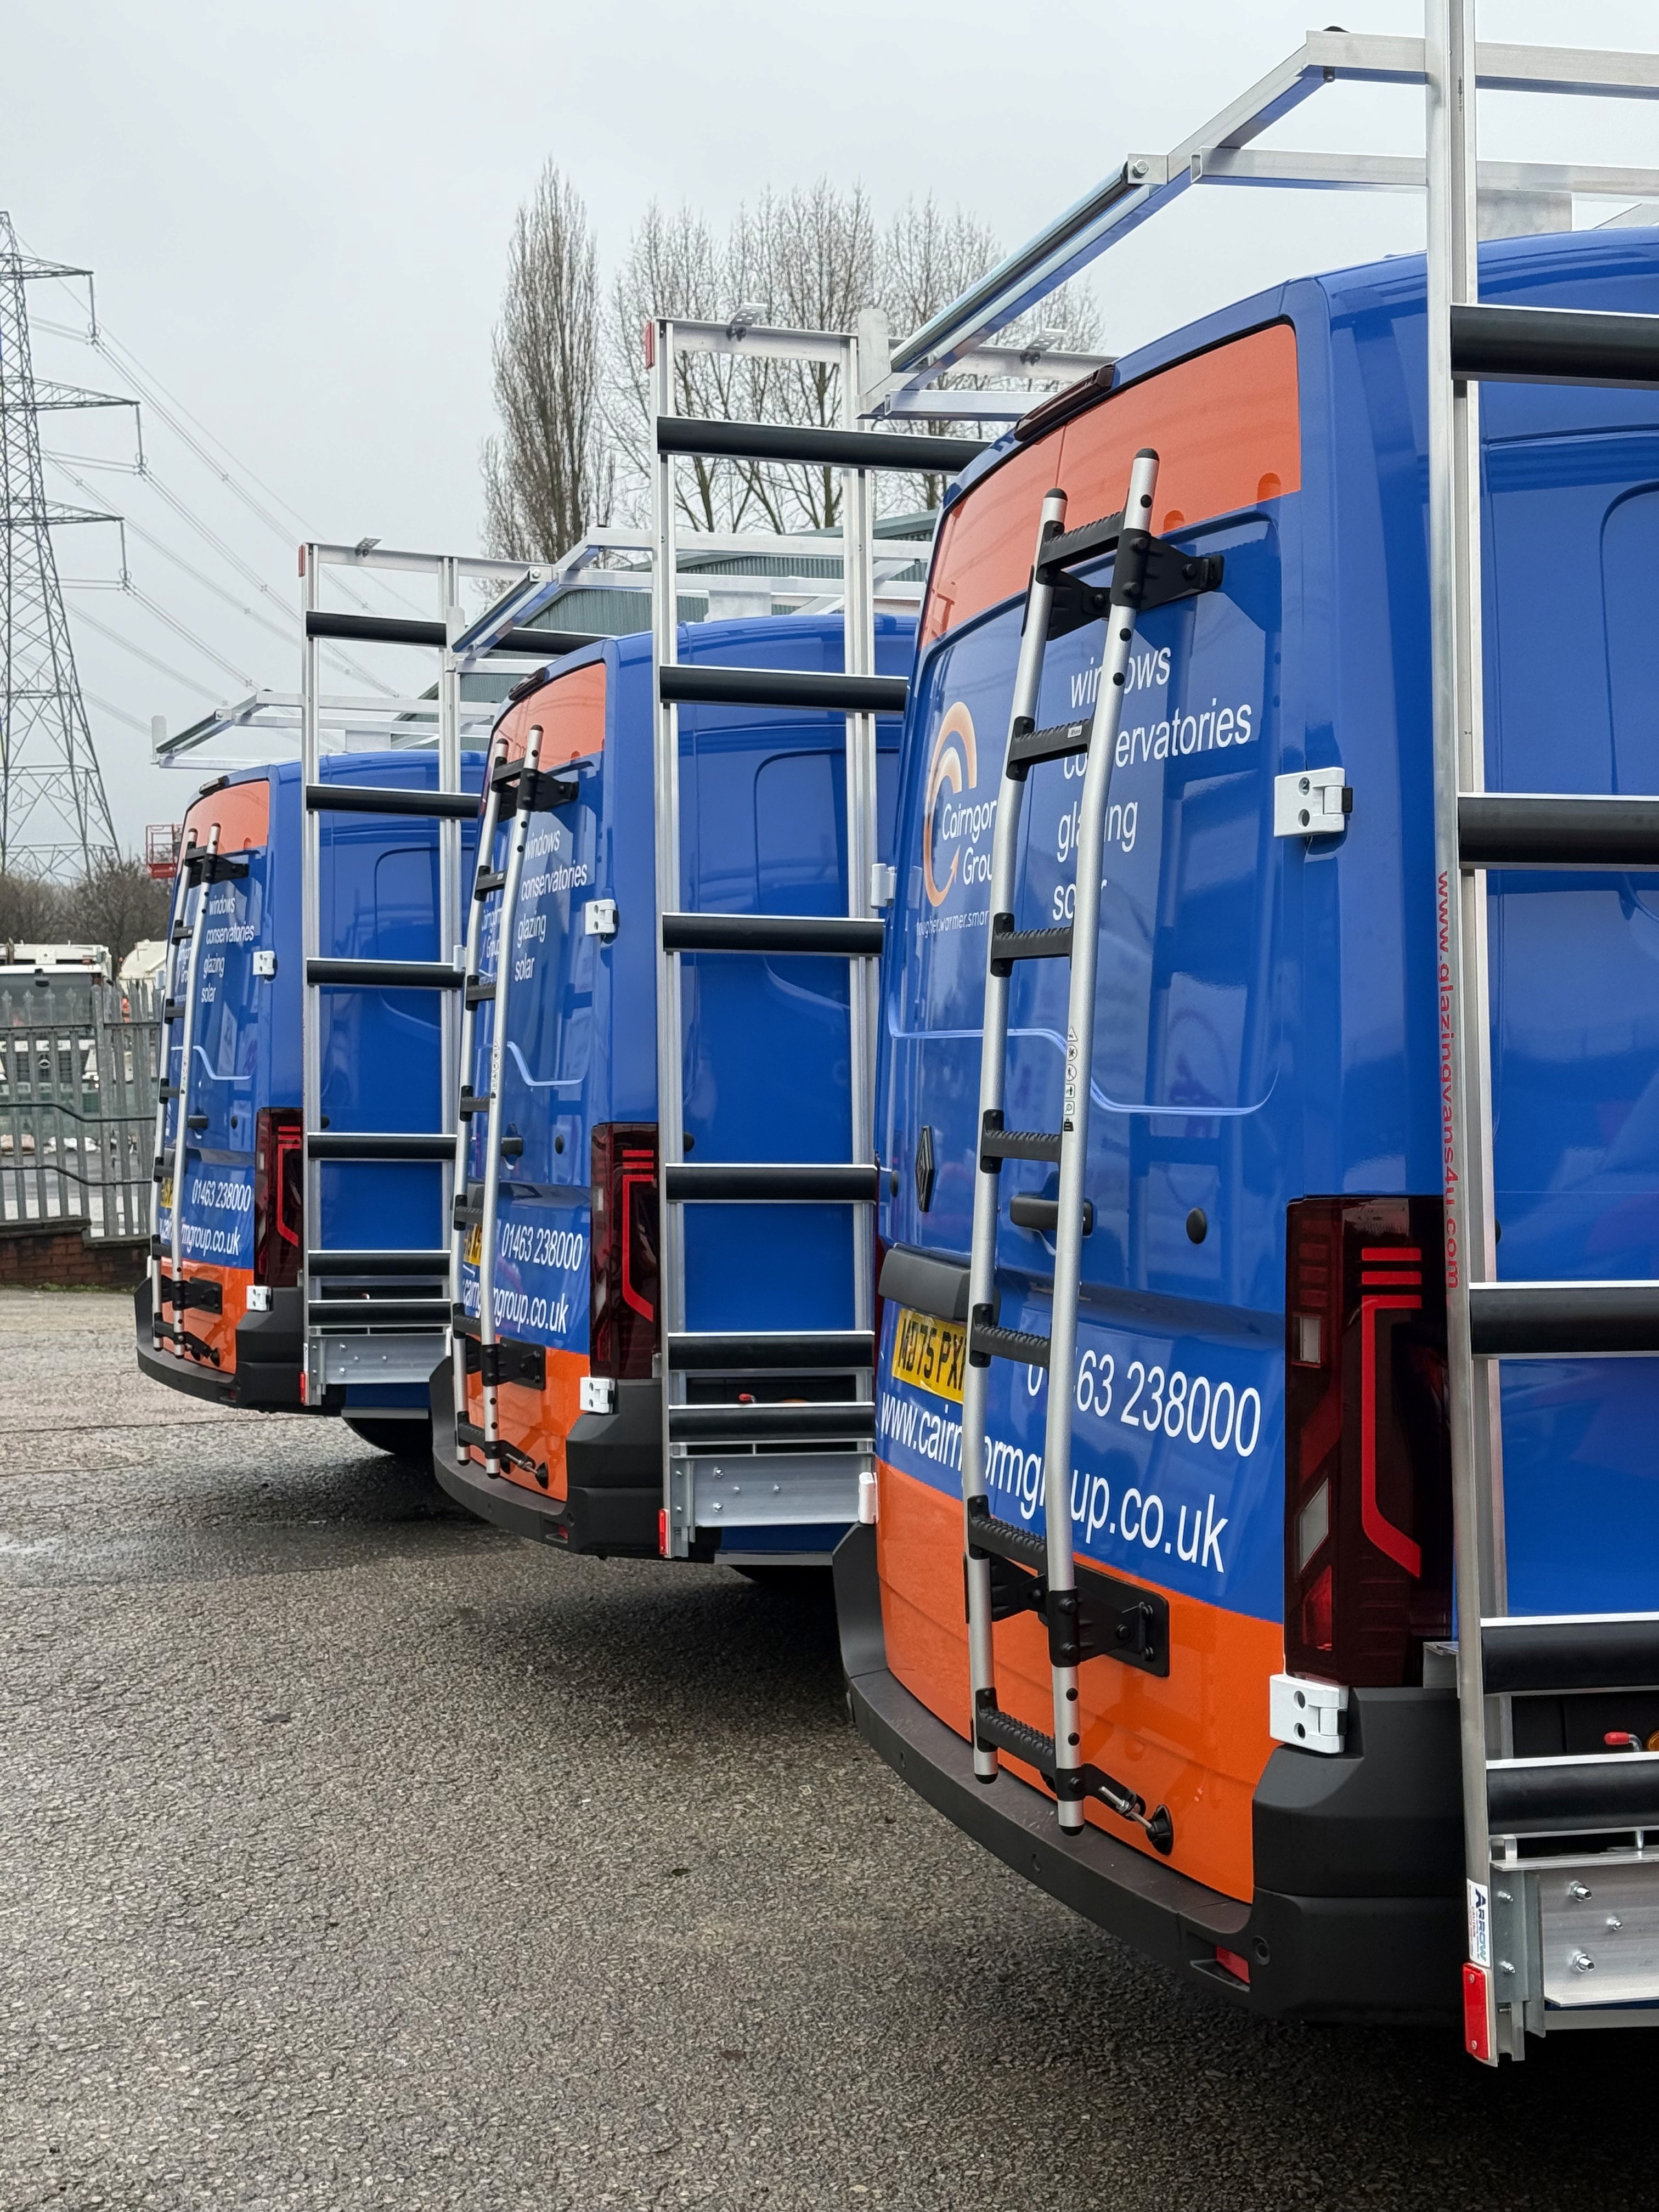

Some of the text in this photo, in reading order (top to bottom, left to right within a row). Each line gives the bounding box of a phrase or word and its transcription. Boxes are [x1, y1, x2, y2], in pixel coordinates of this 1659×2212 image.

[1071, 647, 1171, 708] winows
[1064, 698, 1252, 780] coervatories
[942, 799, 997, 844] Cairngor
[525, 829, 560, 861] windows
[521, 860, 588, 901] conservatories
[209, 894, 235, 916] windows
[206, 921, 255, 945] conservatories
[517, 911, 547, 949] glazing
[203, 953, 225, 979] glazing
[515, 952, 535, 982] solar
[201, 982, 216, 1003] solar
[192, 1179, 216, 1207] 01463
[216, 1181, 252, 1212] 238000
[501, 1223, 534, 1262] 01463
[533, 1228, 583, 1271] 238000
[1028, 1350, 1261, 1457] 063 238000
